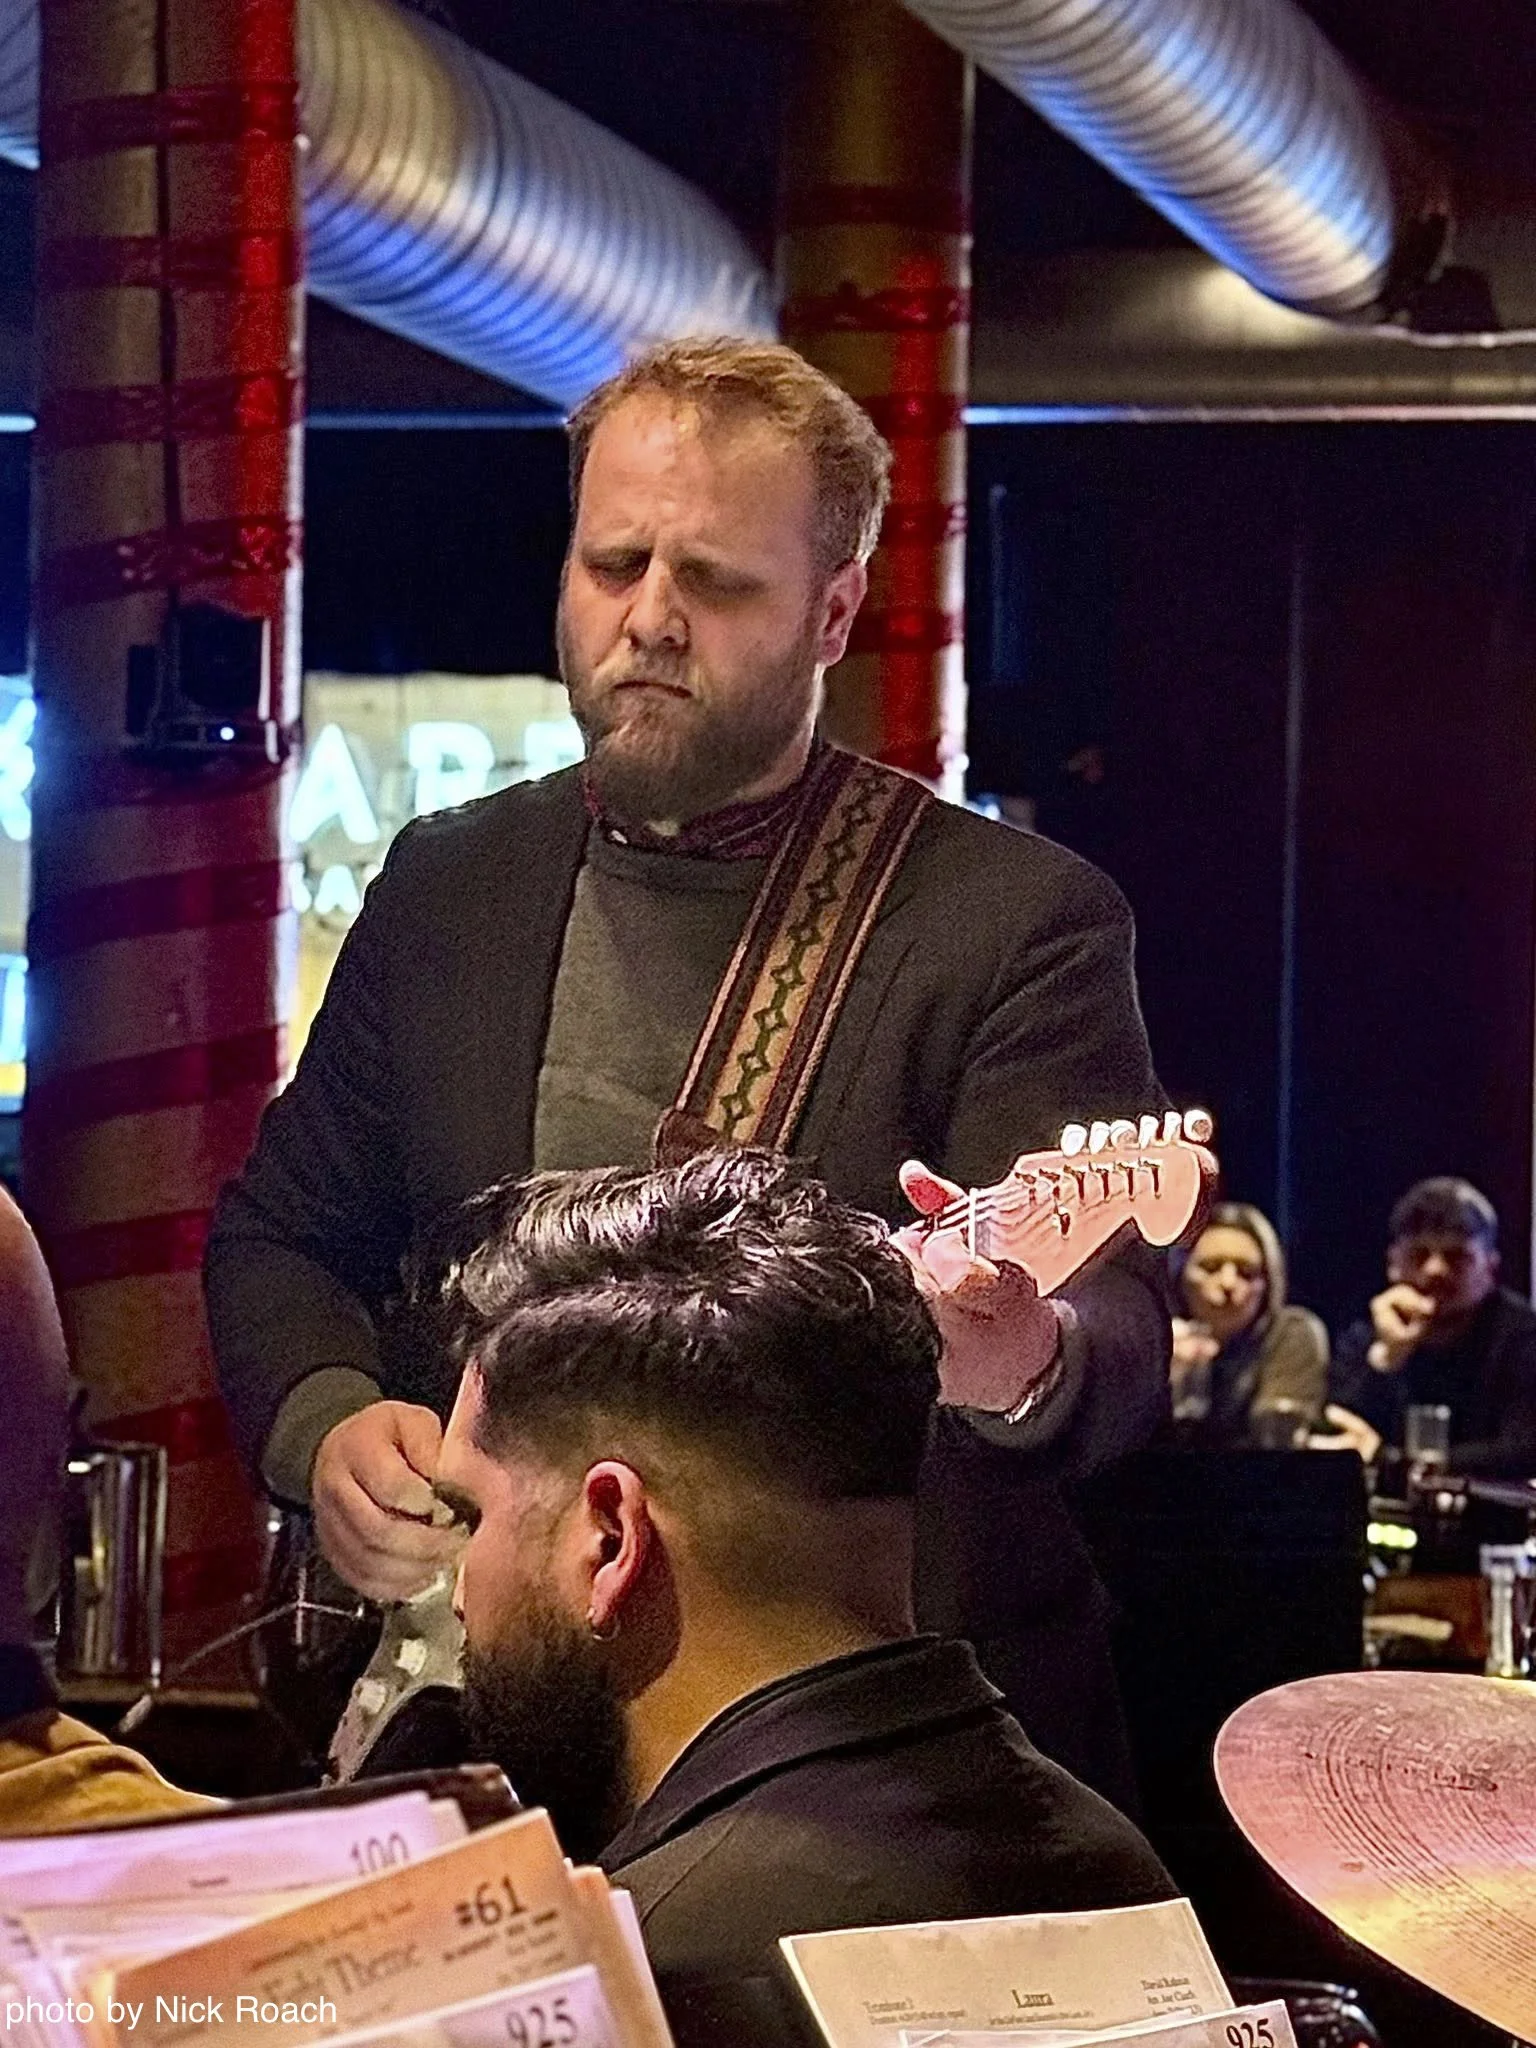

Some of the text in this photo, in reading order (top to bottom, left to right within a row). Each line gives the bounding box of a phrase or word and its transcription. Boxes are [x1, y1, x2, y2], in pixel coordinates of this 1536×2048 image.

[350, 1831, 409, 1877] 100
[1010, 1989, 1055, 2008] Laura
[506, 1998, 578, 2048] 925
[1225, 2018, 1274, 2048] 925
